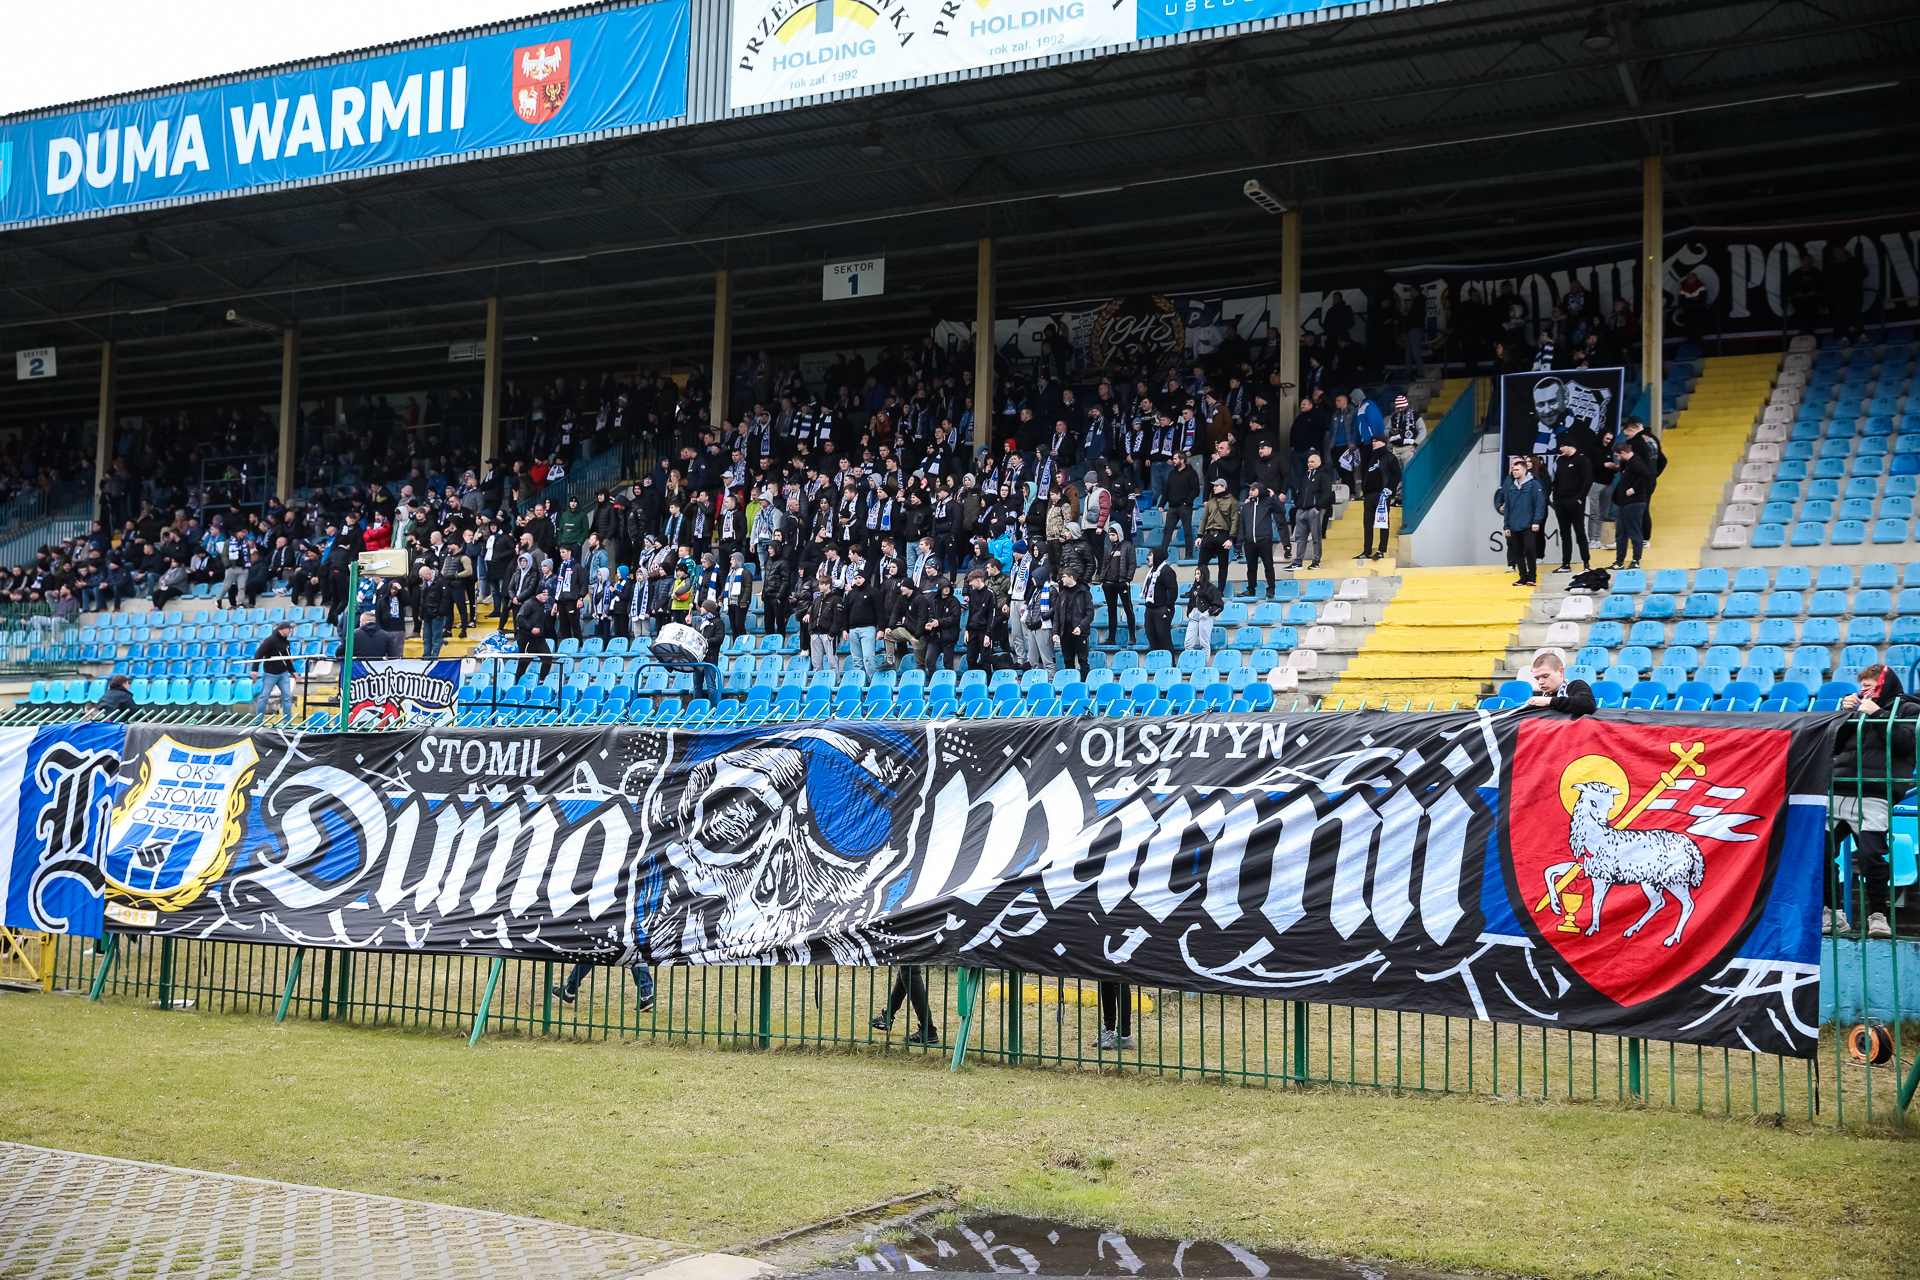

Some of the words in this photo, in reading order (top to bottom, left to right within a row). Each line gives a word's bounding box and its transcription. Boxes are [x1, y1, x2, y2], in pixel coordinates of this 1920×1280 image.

[970, 1, 1085, 37] HOLDING
[772, 39, 876, 72] HOLDING
[989, 45, 1008, 56] rok
[1011, 41, 1032, 53] zał.
[1037, 34, 1065, 48] 1992
[790, 79, 806, 90] rok
[809, 76, 828, 86] zał.
[832, 69, 858, 83] 1992
[46, 115, 209, 195] DUMA
[229, 66, 468, 165] WARMII
[833, 261, 874, 275] SEKTOR
[848, 274, 859, 296] 1
[1099, 312, 1176, 345] 1945
[23, 350, 48, 358] SEKTOR
[29, 358, 45, 376] 2
[416, 735, 546, 778] STOMIL
[1080, 722, 1287, 769] OLSZTYN
[176, 764, 216, 781] OKS
[150, 786, 219, 806] STOMIL
[132, 808, 219, 830] OLSZTYN
[231, 765, 635, 921] Duma
[117, 907, 147, 924] 1945
